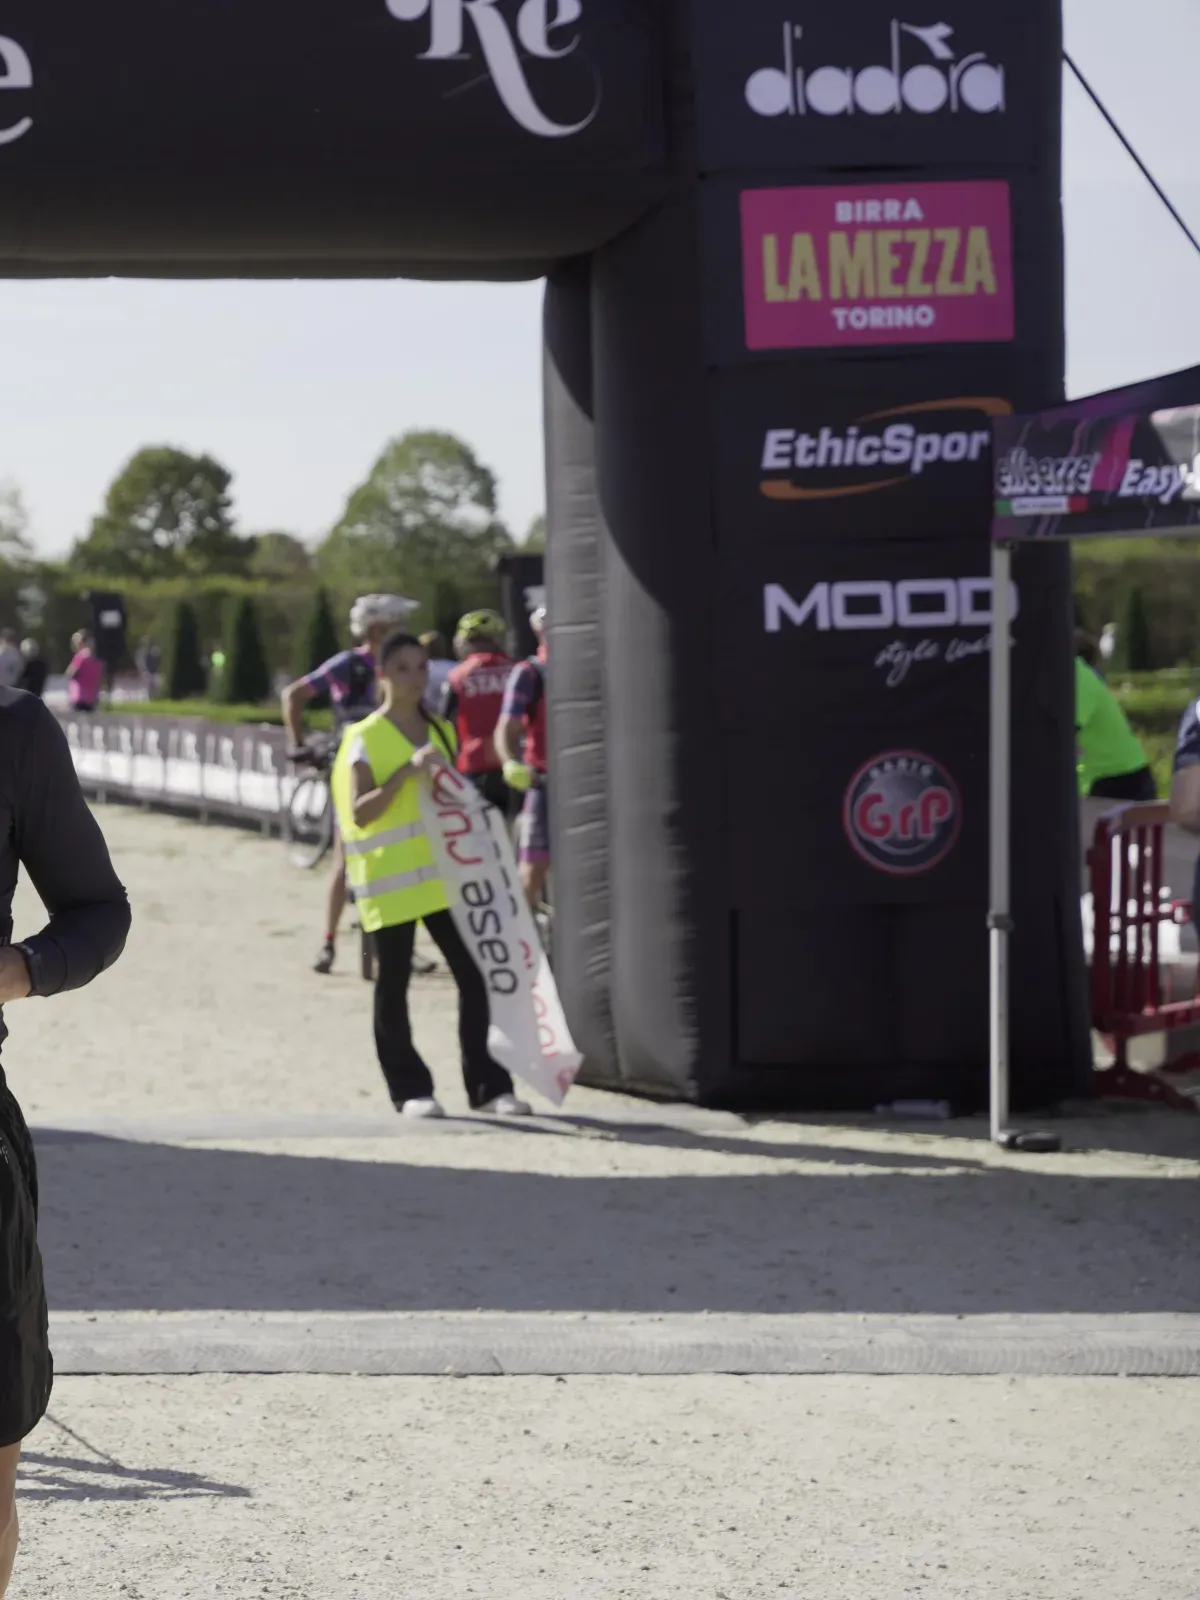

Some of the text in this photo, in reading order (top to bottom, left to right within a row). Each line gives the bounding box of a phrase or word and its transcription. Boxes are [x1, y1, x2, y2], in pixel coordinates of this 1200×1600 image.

[744, 19, 1005, 116] diadora
[835, 199, 924, 223] BIRRA
[762, 226, 997, 302] LA MEZZA
[831, 305, 935, 330] TORINO
[760, 423, 990, 473] EthicSpor
